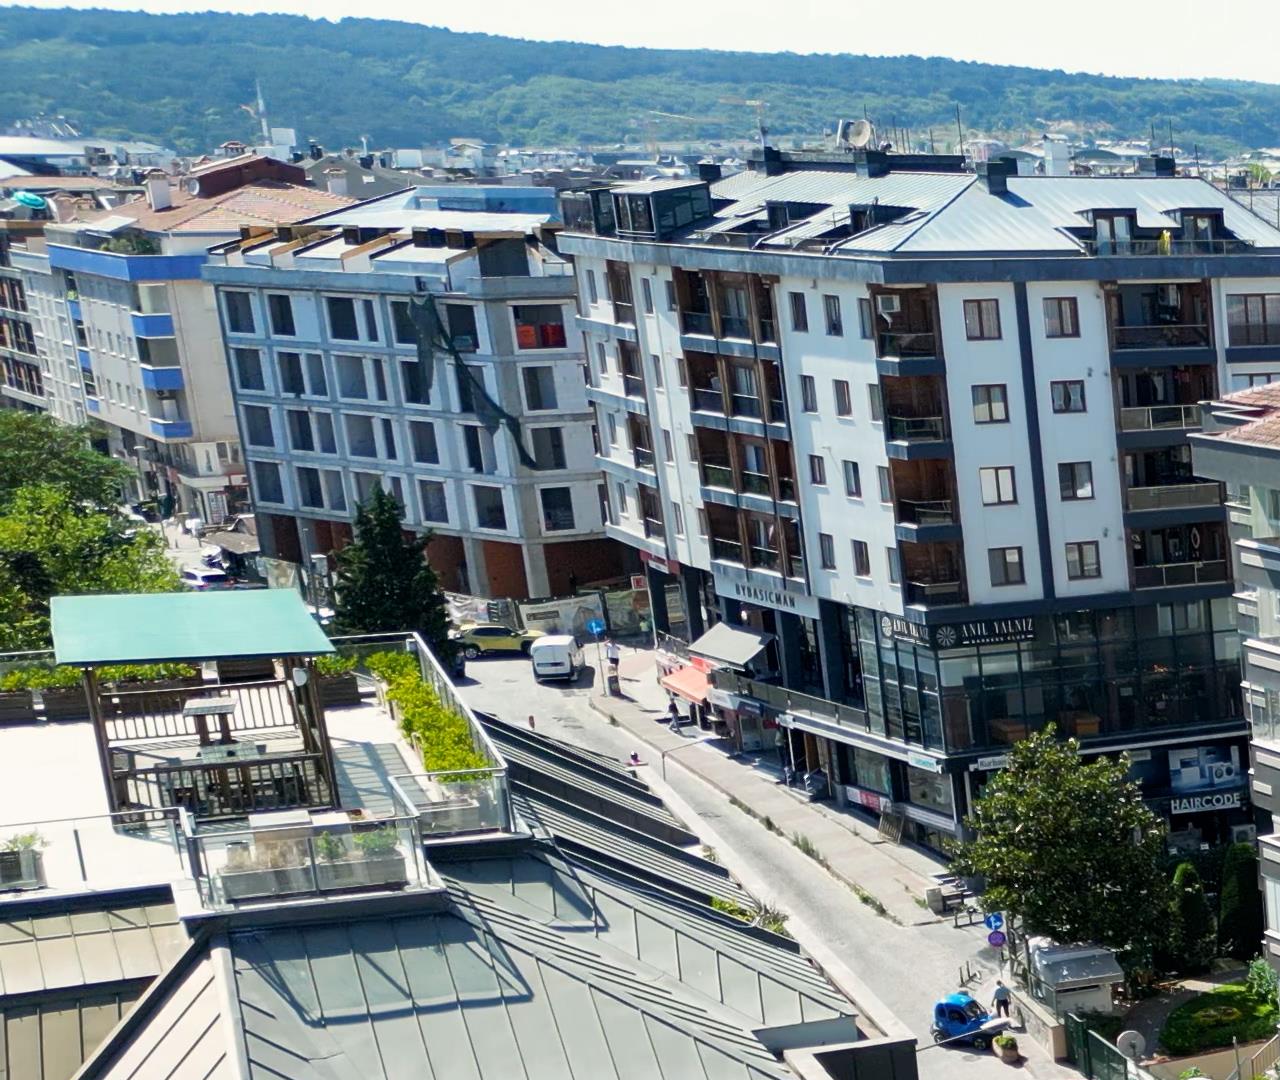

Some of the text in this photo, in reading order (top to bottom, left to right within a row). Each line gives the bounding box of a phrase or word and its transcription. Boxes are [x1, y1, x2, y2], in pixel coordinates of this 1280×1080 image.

[735, 583, 796, 608] BYBASICMAN
[961, 618, 1034, 638] ANIL YALNIZ
[1171, 793, 1240, 812] HAIRCODE
